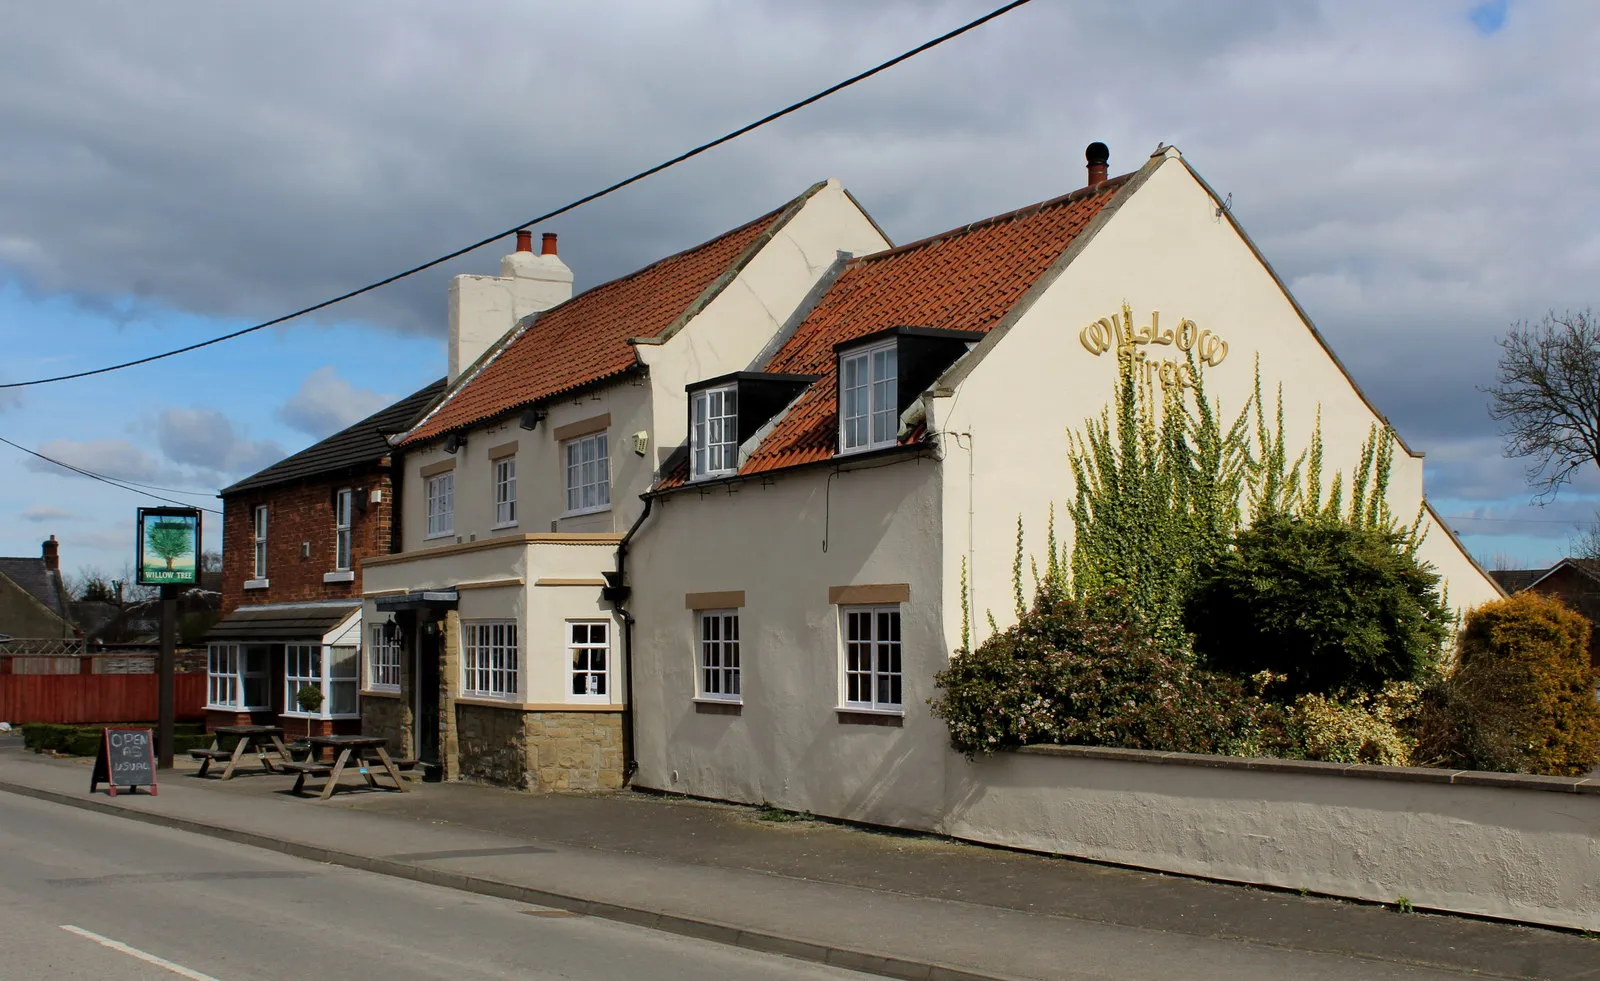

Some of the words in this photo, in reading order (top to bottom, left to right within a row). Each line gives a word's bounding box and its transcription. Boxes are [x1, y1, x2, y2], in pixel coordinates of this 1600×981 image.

[145, 571, 174, 579] WILLOW
[111, 733, 148, 747] OPEN
[122, 746, 143, 758] AS
[114, 761, 150, 771] USUAL
